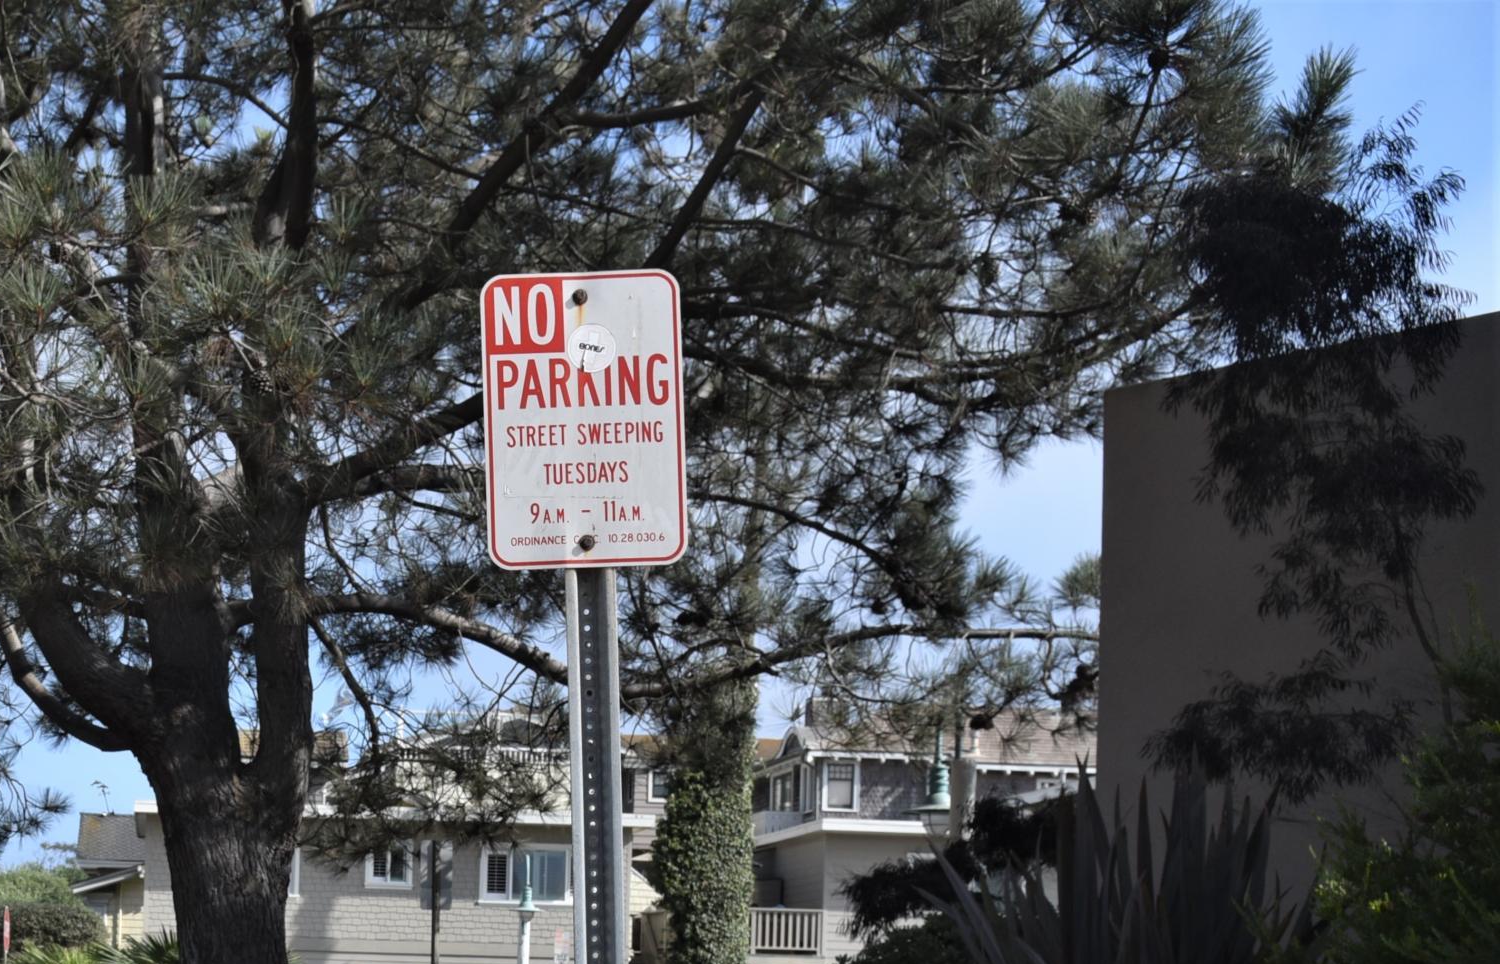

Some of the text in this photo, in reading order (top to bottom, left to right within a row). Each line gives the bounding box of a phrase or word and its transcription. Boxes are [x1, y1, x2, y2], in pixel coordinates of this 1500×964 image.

[493, 284, 556, 346] NO
[496, 354, 670, 410] PARKING
[506, 421, 664, 448] STREET SWEEPING
[543, 461, 629, 486] TUESDAYS
[510, 535, 567, 547] ORDINANCE
[607, 532, 666, 544] 10.28.030.6
